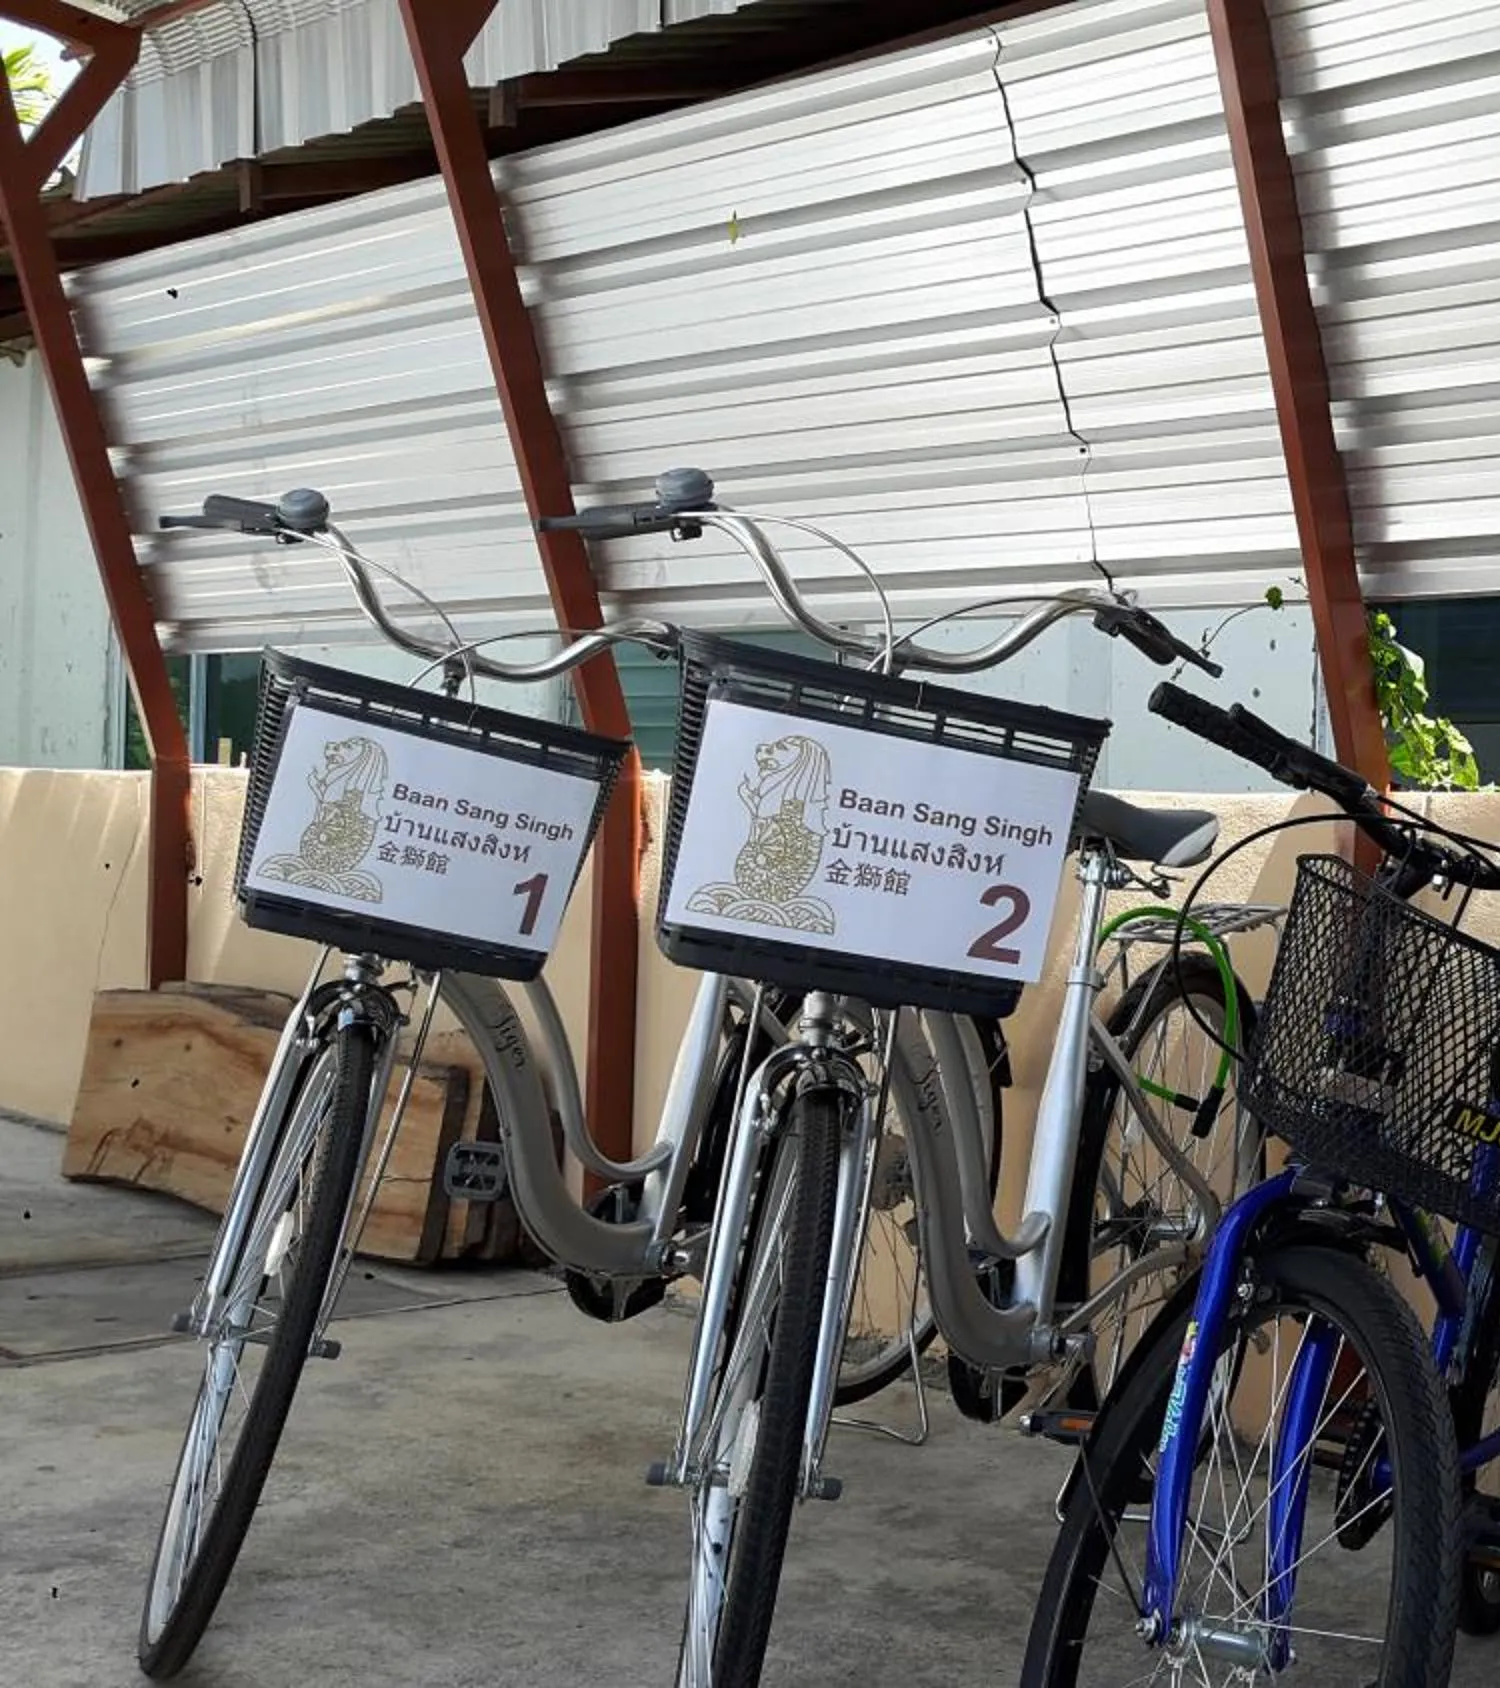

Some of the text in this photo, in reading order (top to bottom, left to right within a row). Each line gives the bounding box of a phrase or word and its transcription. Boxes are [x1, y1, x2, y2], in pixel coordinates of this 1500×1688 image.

[392, 783, 574, 841] Baan Sang Singh
[839, 788, 1053, 848] Baan Sang Singh
[513, 872, 549, 936] 1
[825, 858, 911, 896] 金獅館
[966, 884, 1031, 965] 2
